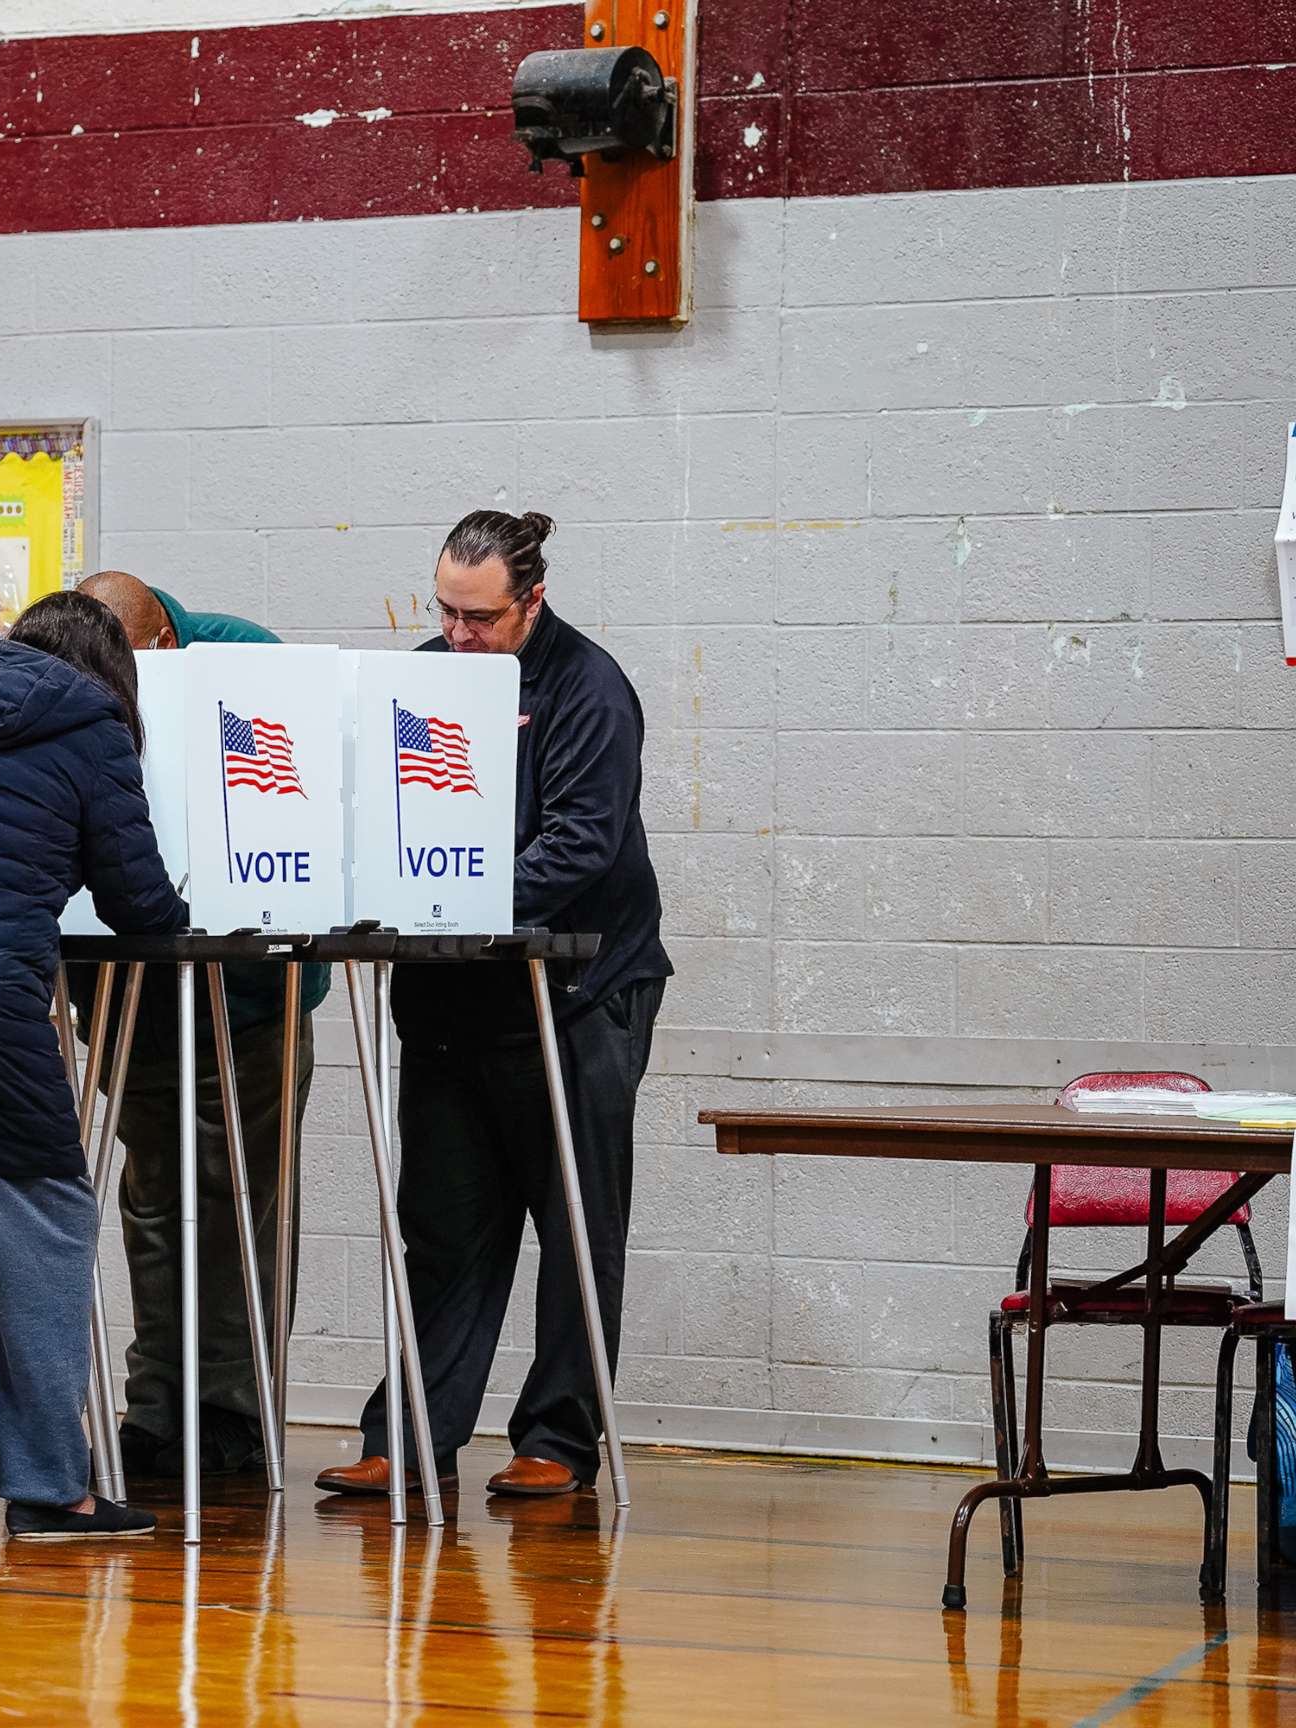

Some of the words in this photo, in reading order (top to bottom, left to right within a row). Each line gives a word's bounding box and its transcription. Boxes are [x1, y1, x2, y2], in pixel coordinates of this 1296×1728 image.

[63, 467, 74, 520] MESSIAH
[235, 851, 311, 883] VOTE
[406, 846, 485, 877] VOTE
